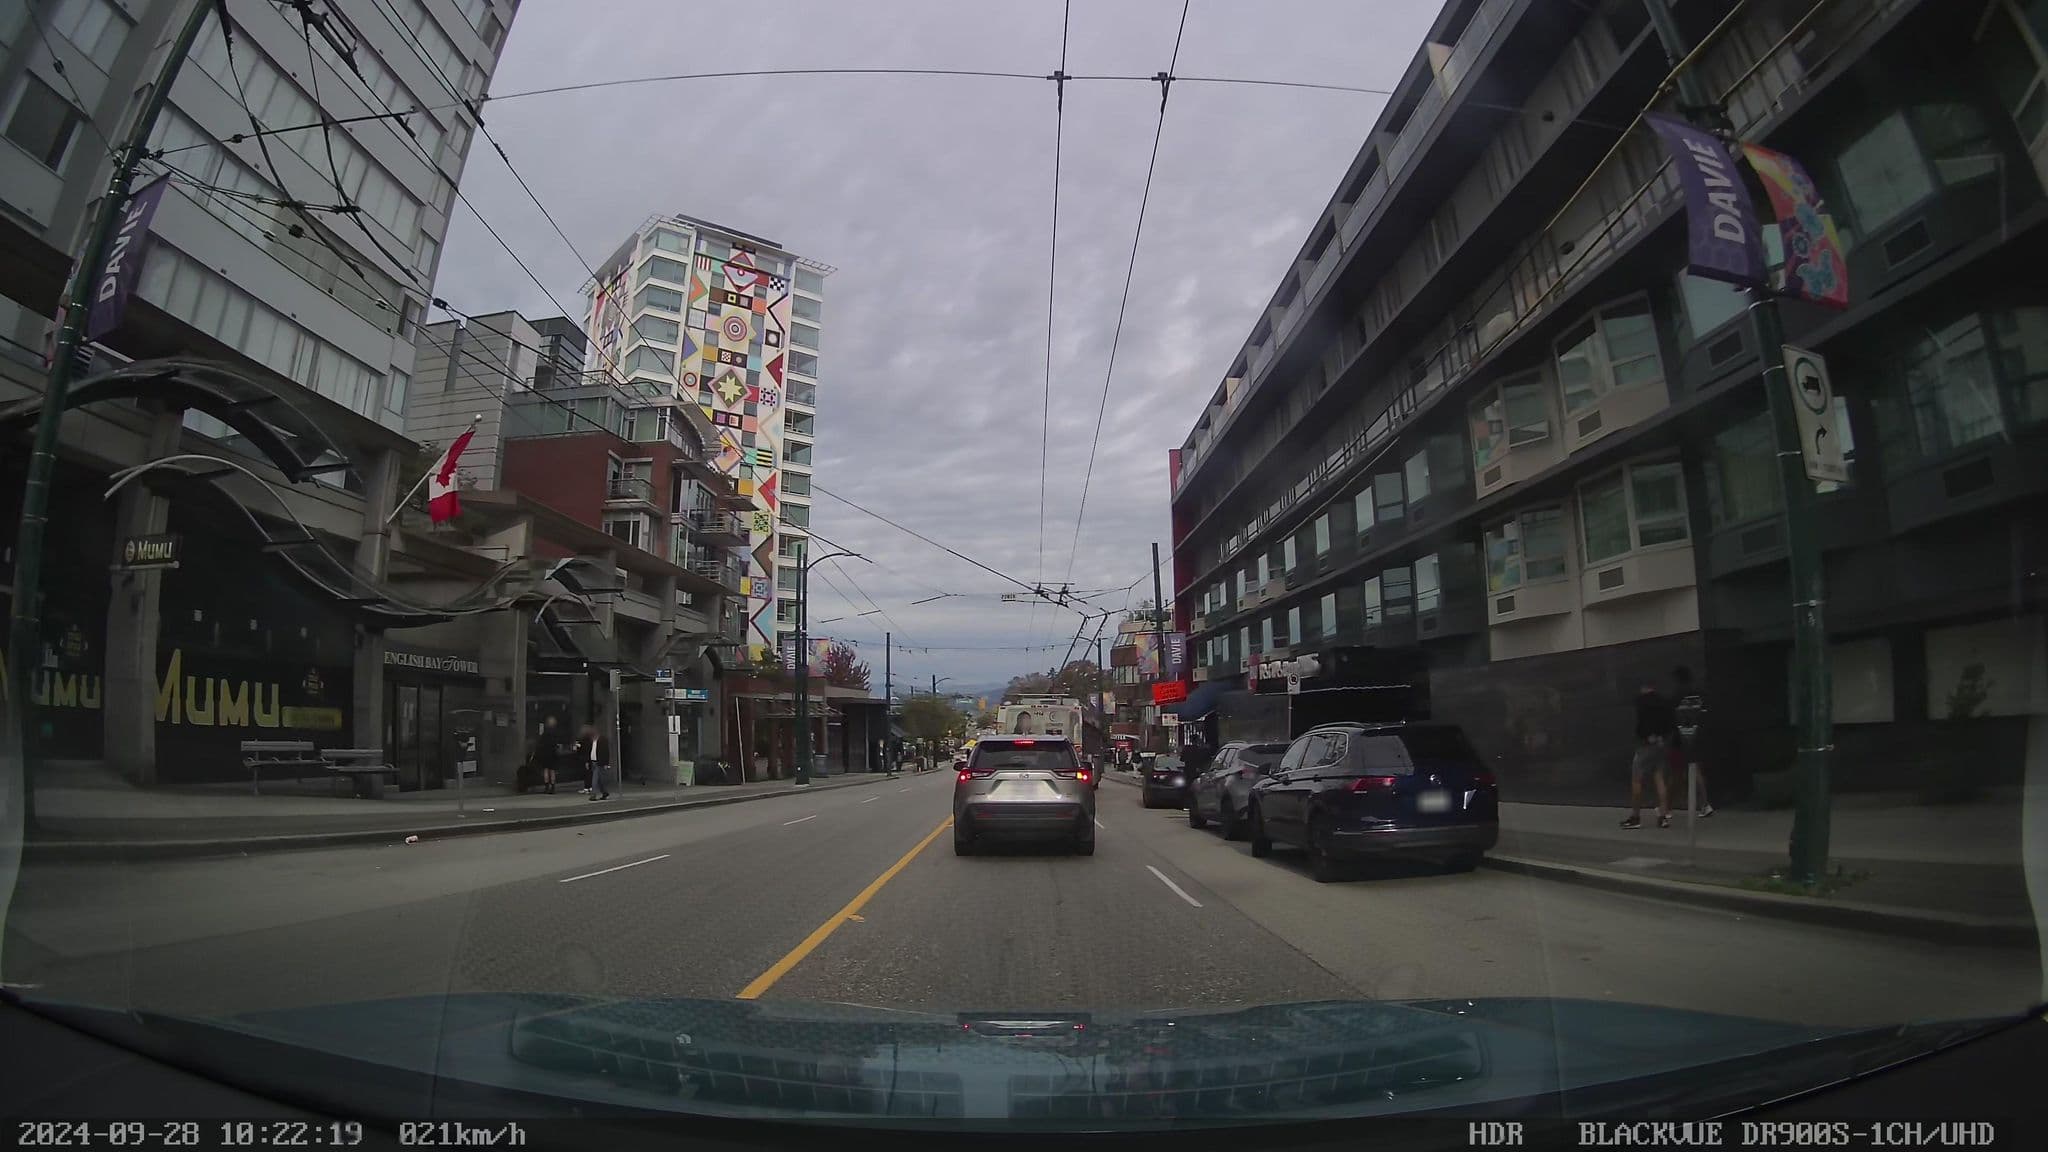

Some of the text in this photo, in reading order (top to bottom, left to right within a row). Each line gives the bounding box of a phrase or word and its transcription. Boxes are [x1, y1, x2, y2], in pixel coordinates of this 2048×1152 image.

[1682, 138, 1745, 245] DAVIE
[99, 201, 148, 302] DAVIE
[384, 651, 479, 674] ENGLISH BAY TOWER
[785, 646, 796, 670] DAVIE
[1170, 638, 1182, 665] DAVIE
